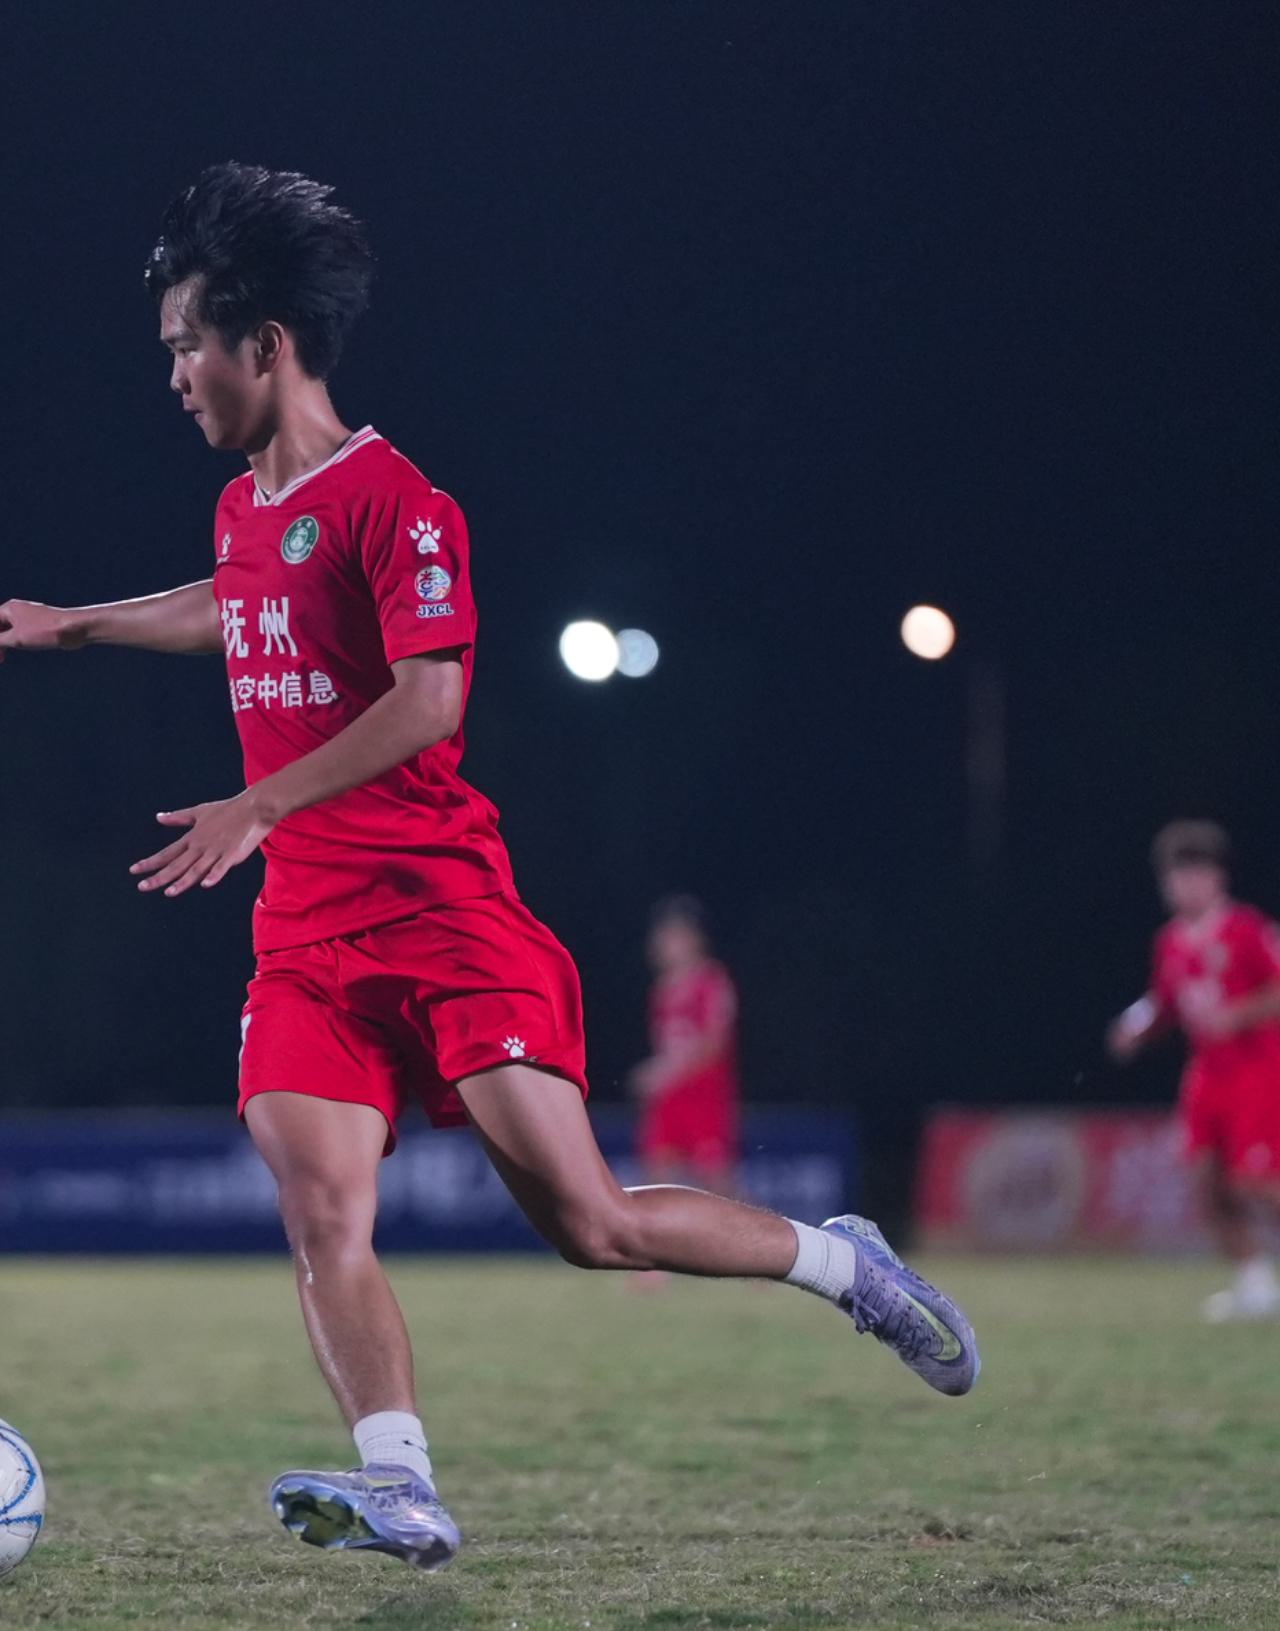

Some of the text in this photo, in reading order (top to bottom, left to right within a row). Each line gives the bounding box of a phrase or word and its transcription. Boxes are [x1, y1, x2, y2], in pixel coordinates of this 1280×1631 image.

[417, 603, 454, 617] JXCL
[230, 670, 338, 712] 空中信息
